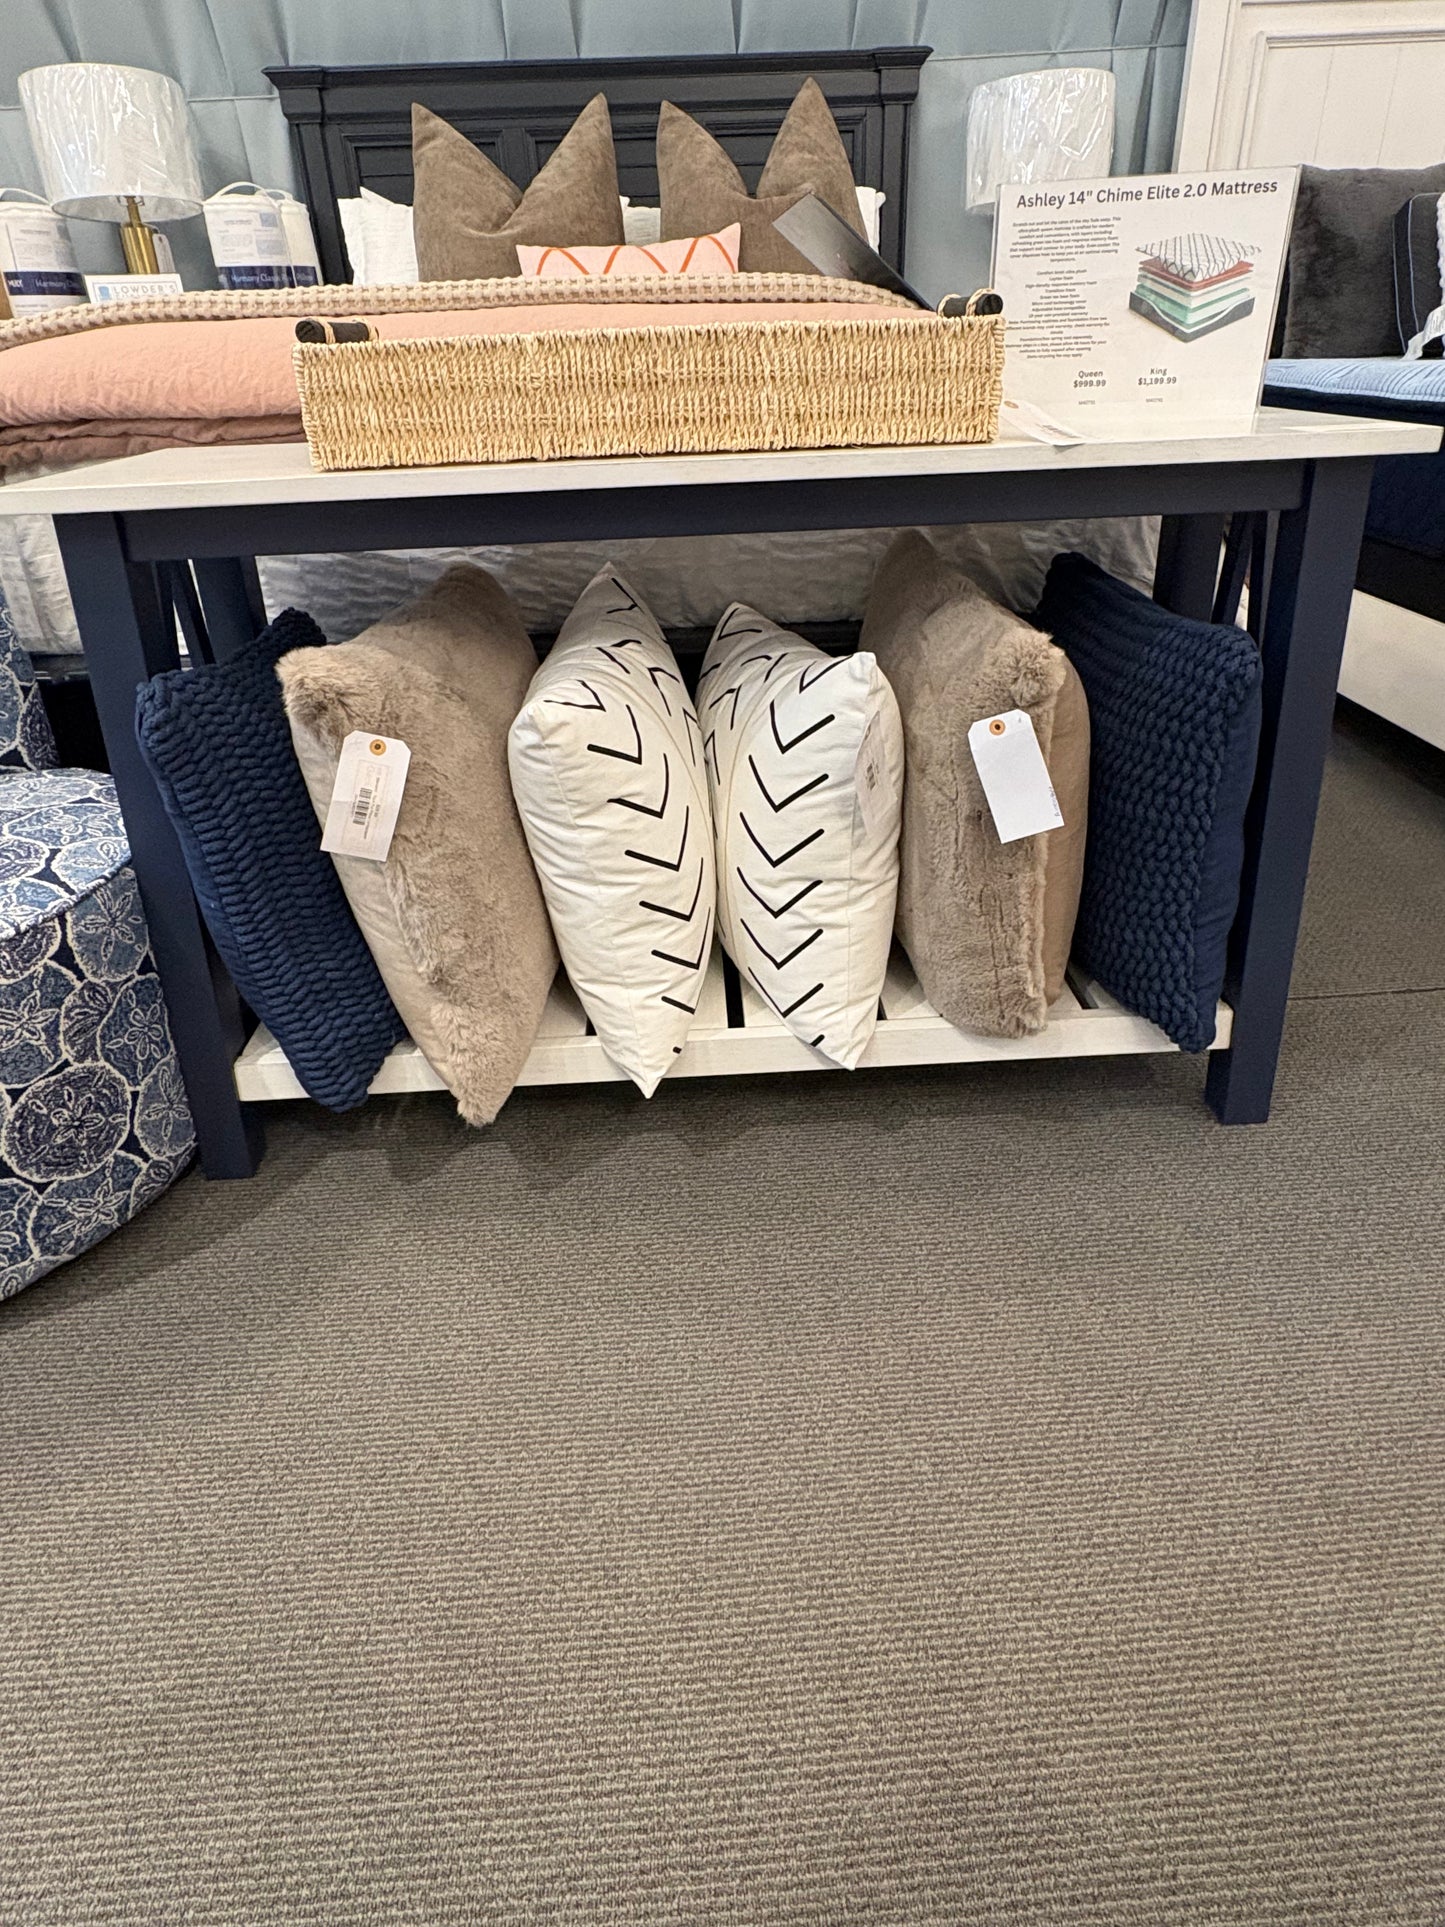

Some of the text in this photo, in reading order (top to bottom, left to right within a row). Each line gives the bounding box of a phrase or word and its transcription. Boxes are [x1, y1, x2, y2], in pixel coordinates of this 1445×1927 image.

[1016, 181, 1278, 210] Ashley 14" Chime Elite 2.0 Mattress
[113, 285, 176, 295] LOWDER'S
[1078, 370, 1104, 379] Queen
[1150, 367, 1168, 376] King
[1073, 379, 1107, 388] $999.99
